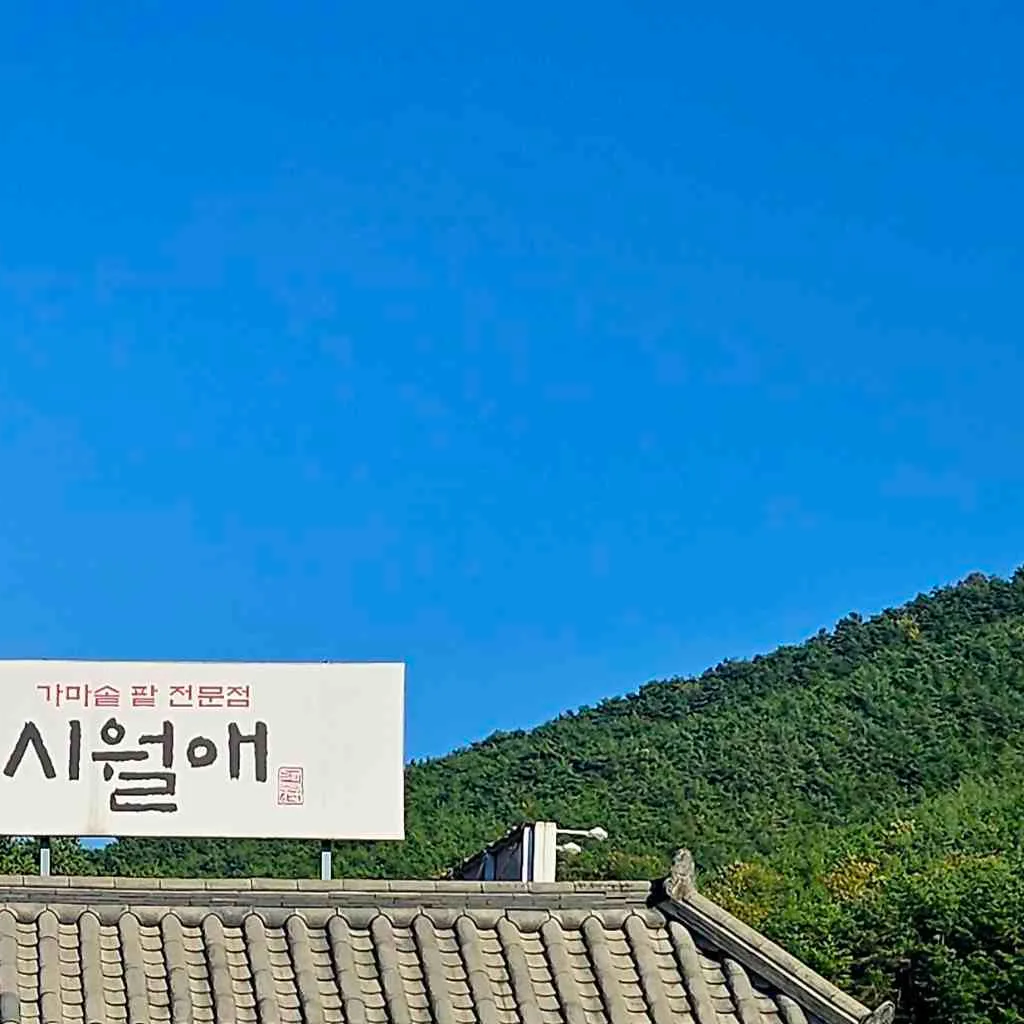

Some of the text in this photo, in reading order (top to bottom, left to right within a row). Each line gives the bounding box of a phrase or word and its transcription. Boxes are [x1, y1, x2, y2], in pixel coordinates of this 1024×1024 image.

[37, 684, 250, 709] 가마솥 팥 전문점
[3, 717, 269, 813] 시월애
